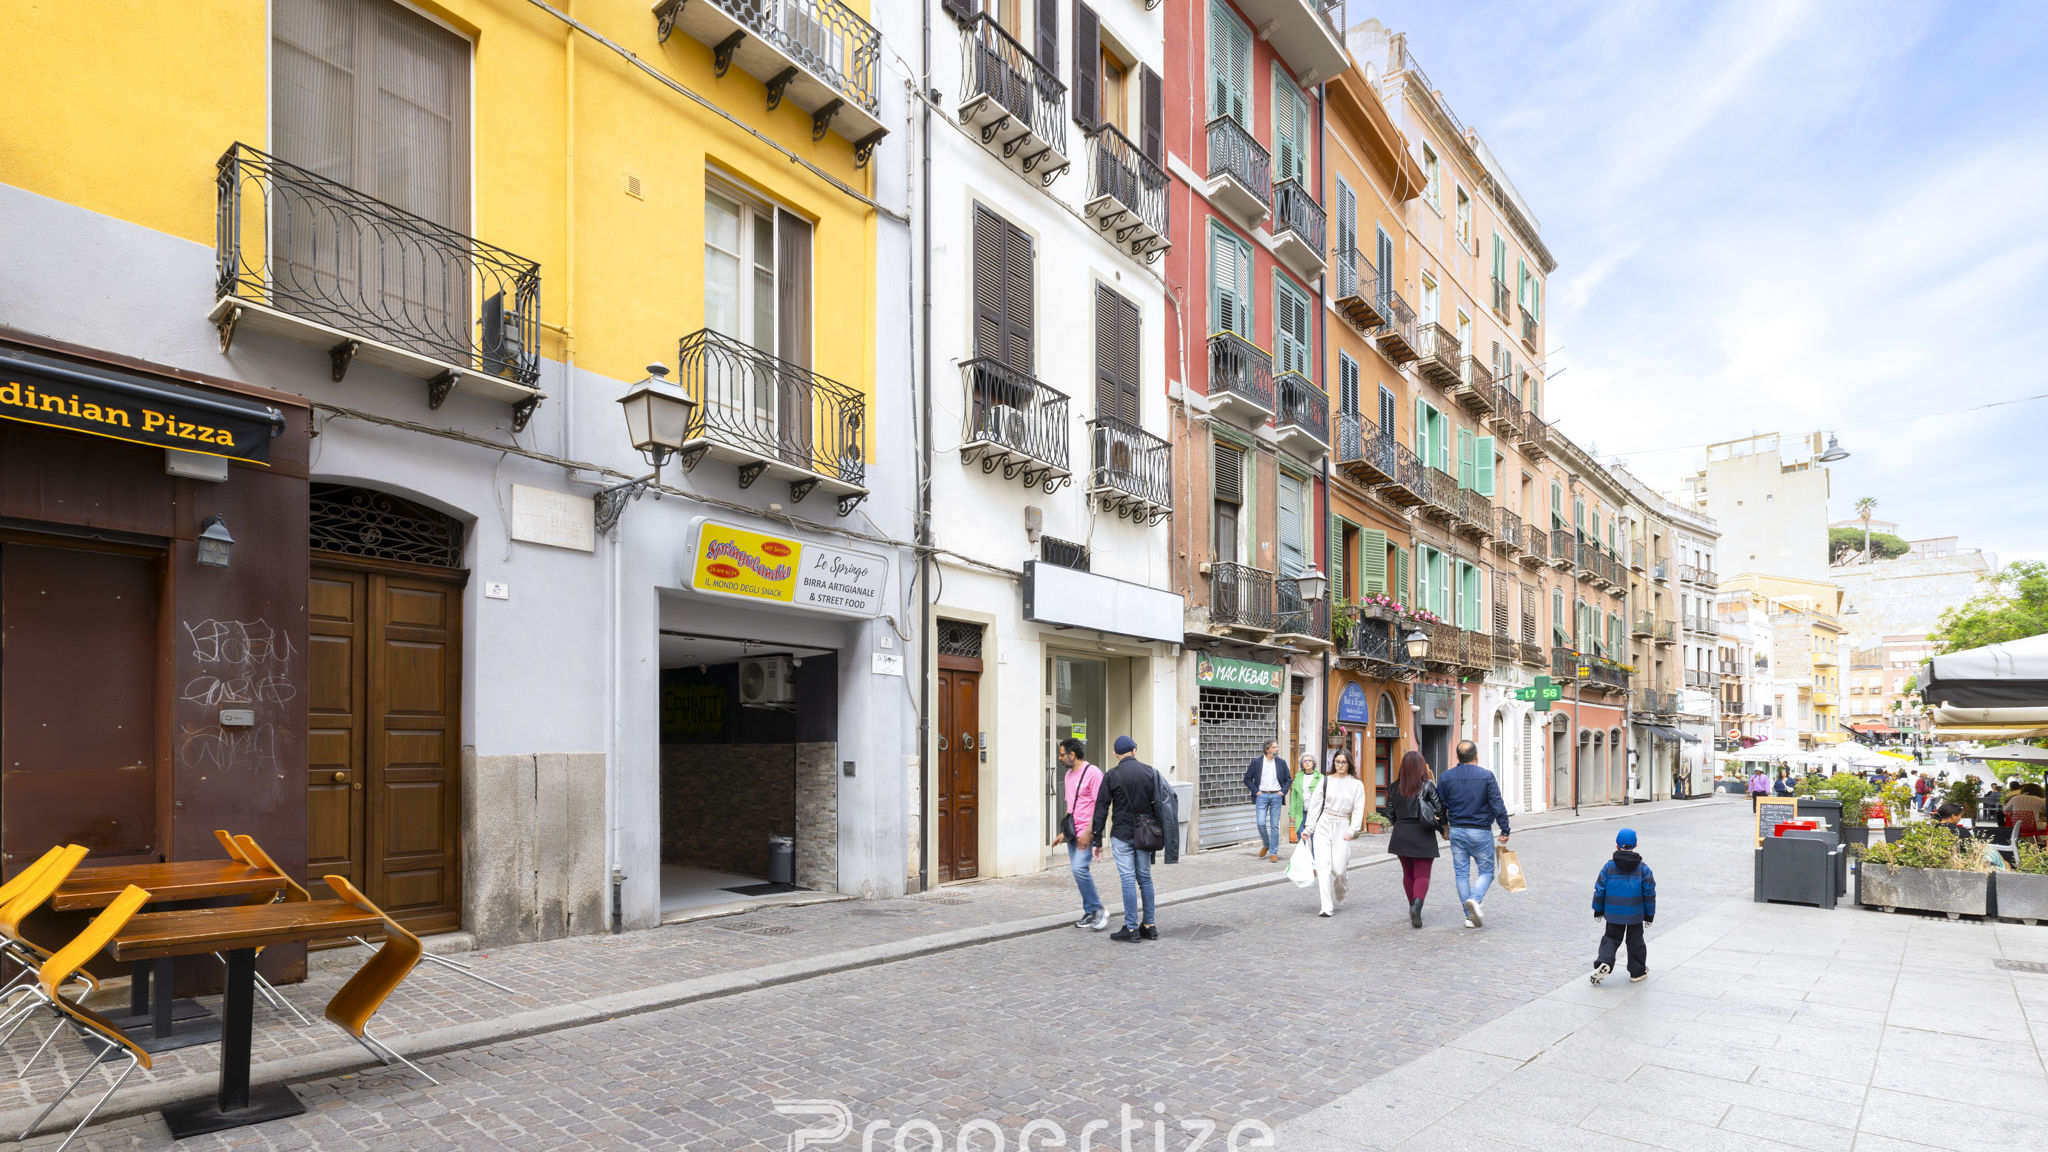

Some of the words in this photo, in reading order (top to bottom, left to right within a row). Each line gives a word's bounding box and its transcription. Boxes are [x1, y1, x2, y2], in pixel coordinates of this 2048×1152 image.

[0, 382, 131, 428] dinian
[142, 409, 235, 447] Pizza
[814, 553, 828, 570] Le
[830, 556, 869, 583] Springo
[705, 578, 711, 586] IL
[713, 580, 739, 591] MONDO
[740, 583, 760, 594] DEGLI
[761, 587, 783, 598] SNACK
[803, 578, 827, 589] BIRRA
[828, 582, 876, 597] ARTIGIANALE
[809, 592, 816, 601] &
[817, 594, 845, 606] STREET
[845, 599, 866, 609] FOOD
[1216, 665, 1238, 682] MAC
[1238, 666, 1270, 686] KEBAB
[1543, 689, 1558, 698] 56
